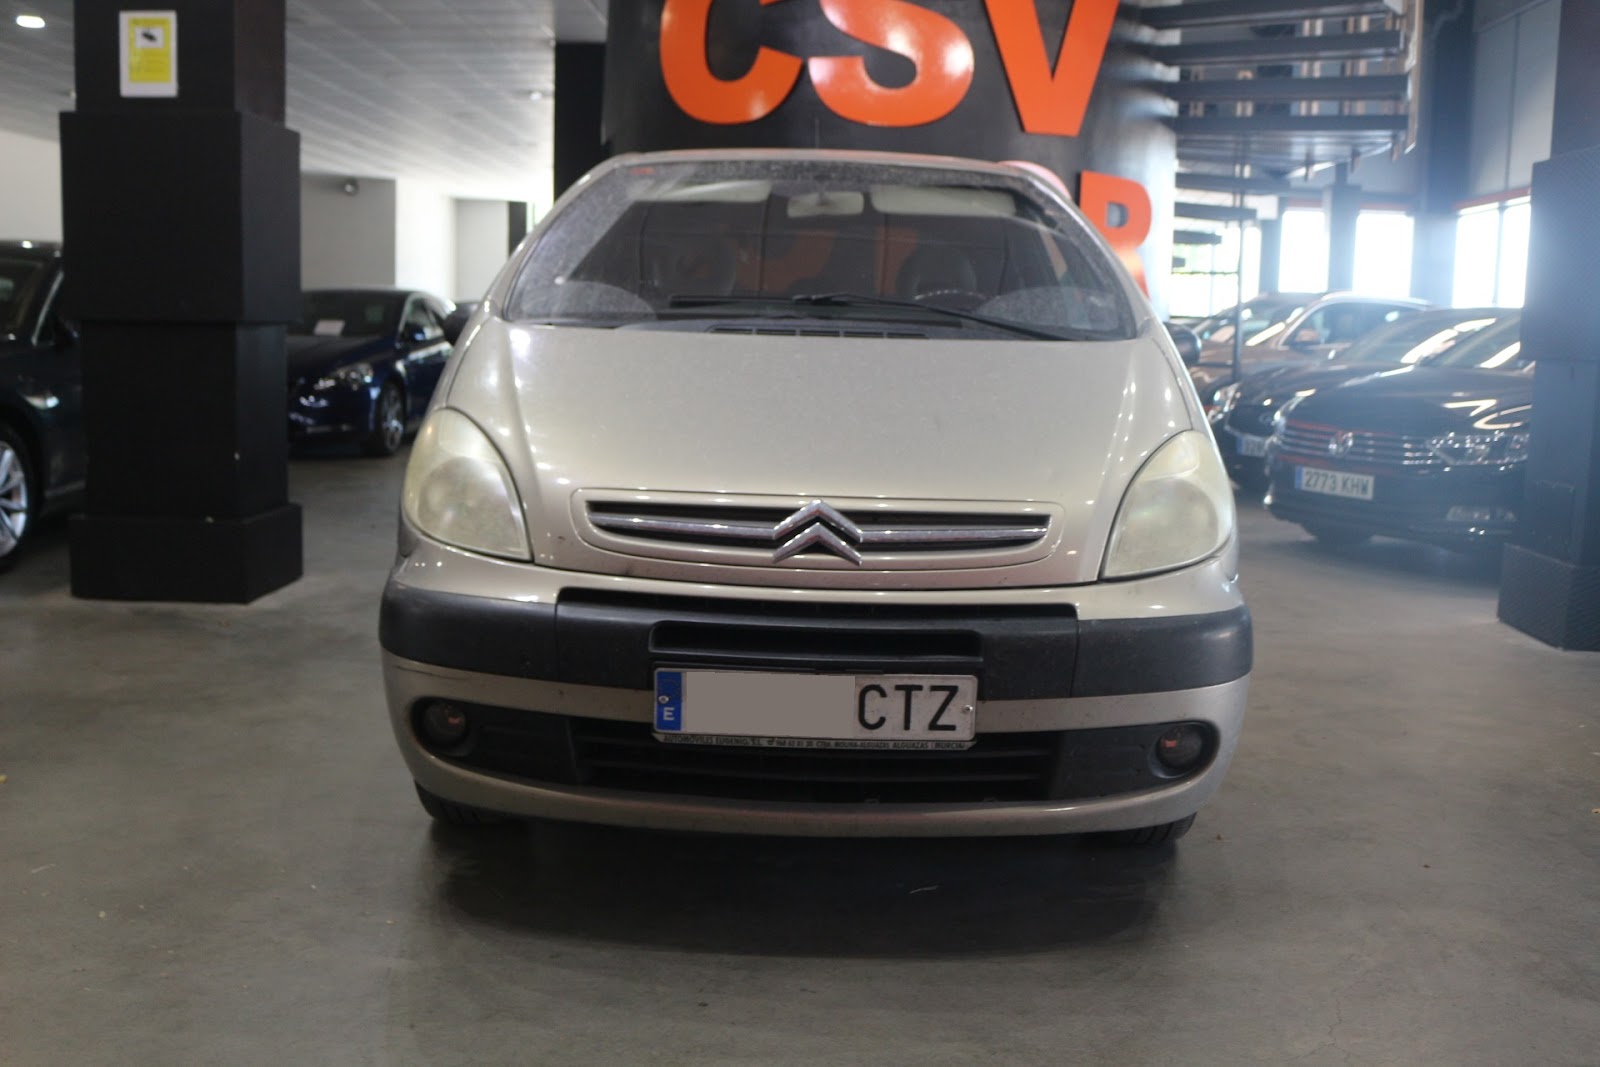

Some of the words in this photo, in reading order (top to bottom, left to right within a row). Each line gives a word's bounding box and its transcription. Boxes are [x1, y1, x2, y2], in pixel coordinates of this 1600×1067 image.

[660, 0, 1119, 137] CSV
[1304, 471, 1337, 492] 2773
[663, 706, 675, 721] E
[858, 684, 959, 731] CTZ
